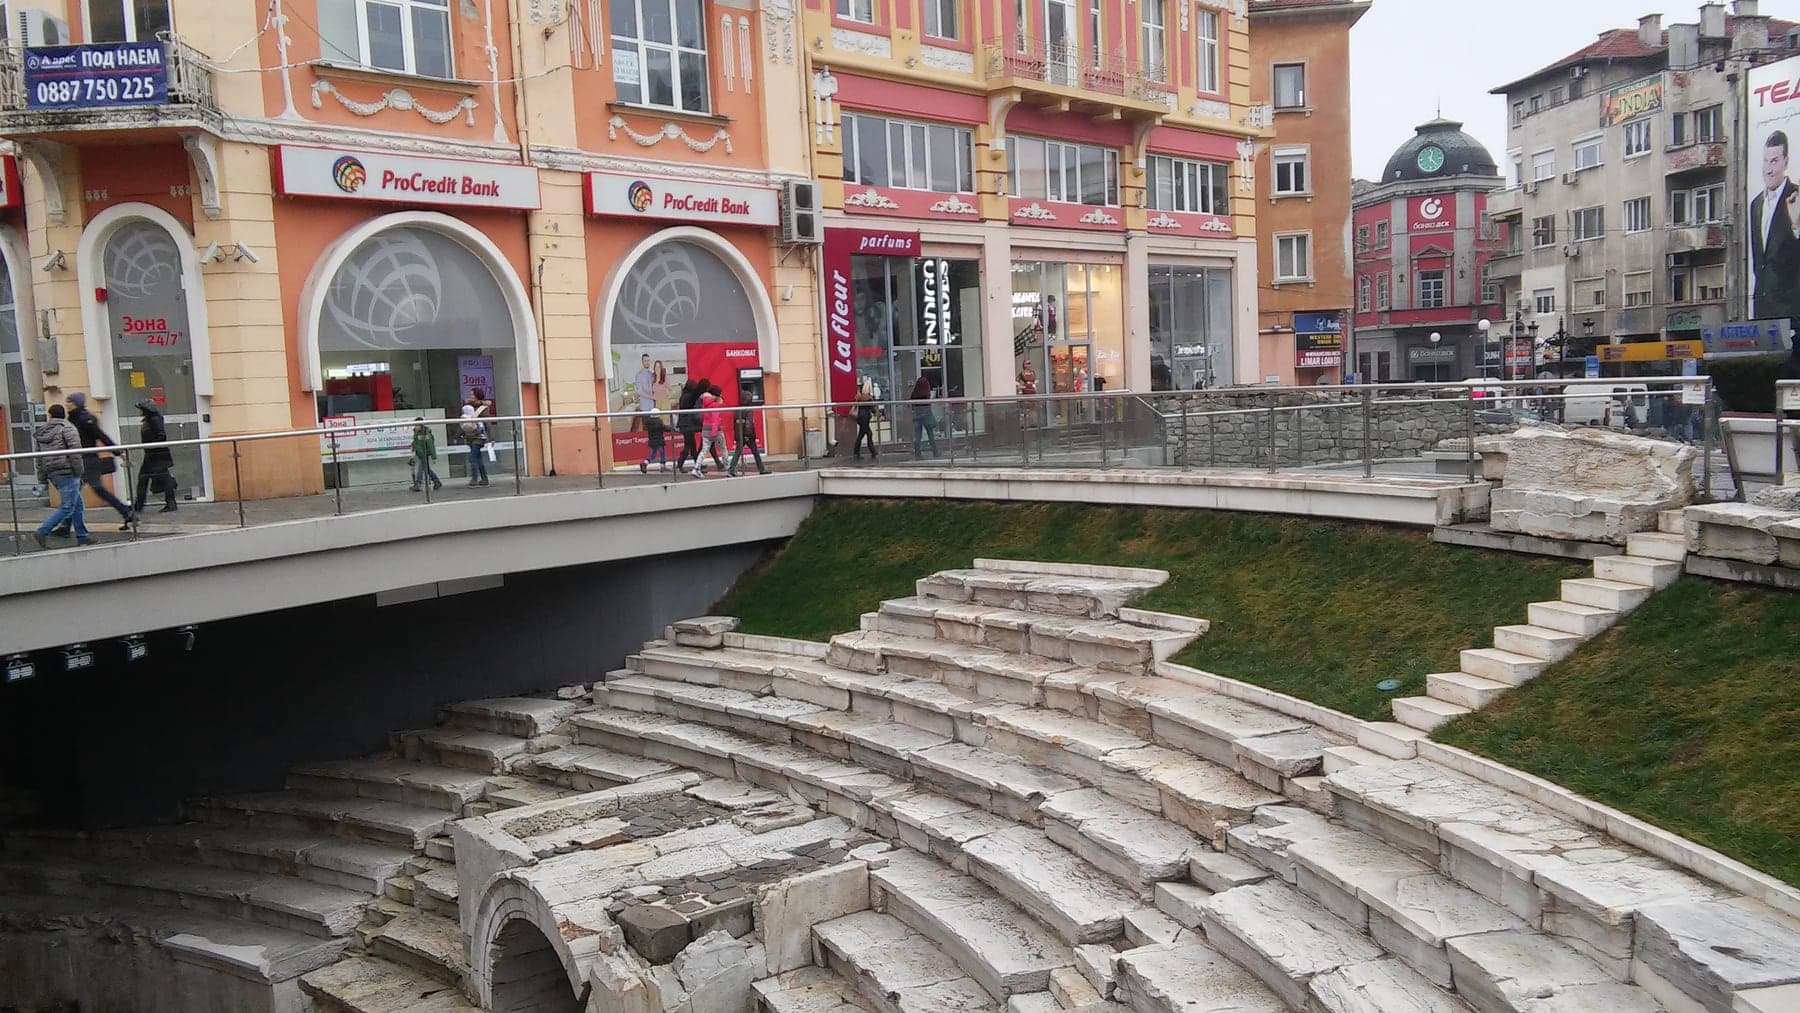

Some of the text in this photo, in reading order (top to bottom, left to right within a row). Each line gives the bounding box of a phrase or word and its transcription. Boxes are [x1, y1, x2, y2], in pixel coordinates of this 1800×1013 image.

[82, 48, 161, 69] ПОД НАЕМ
[37, 76, 154, 103] 0887 750 225
[1619, 88, 1660, 114] INDIA
[381, 169, 500, 197] ProCredit Bank
[663, 192, 750, 215] ProCredit Bank
[860, 234, 913, 250] parfums
[122, 315, 168, 332] Зона
[831, 269, 853, 373] La fleur
[147, 332, 179, 346] 24/7
[462, 374, 487, 385] Зона
